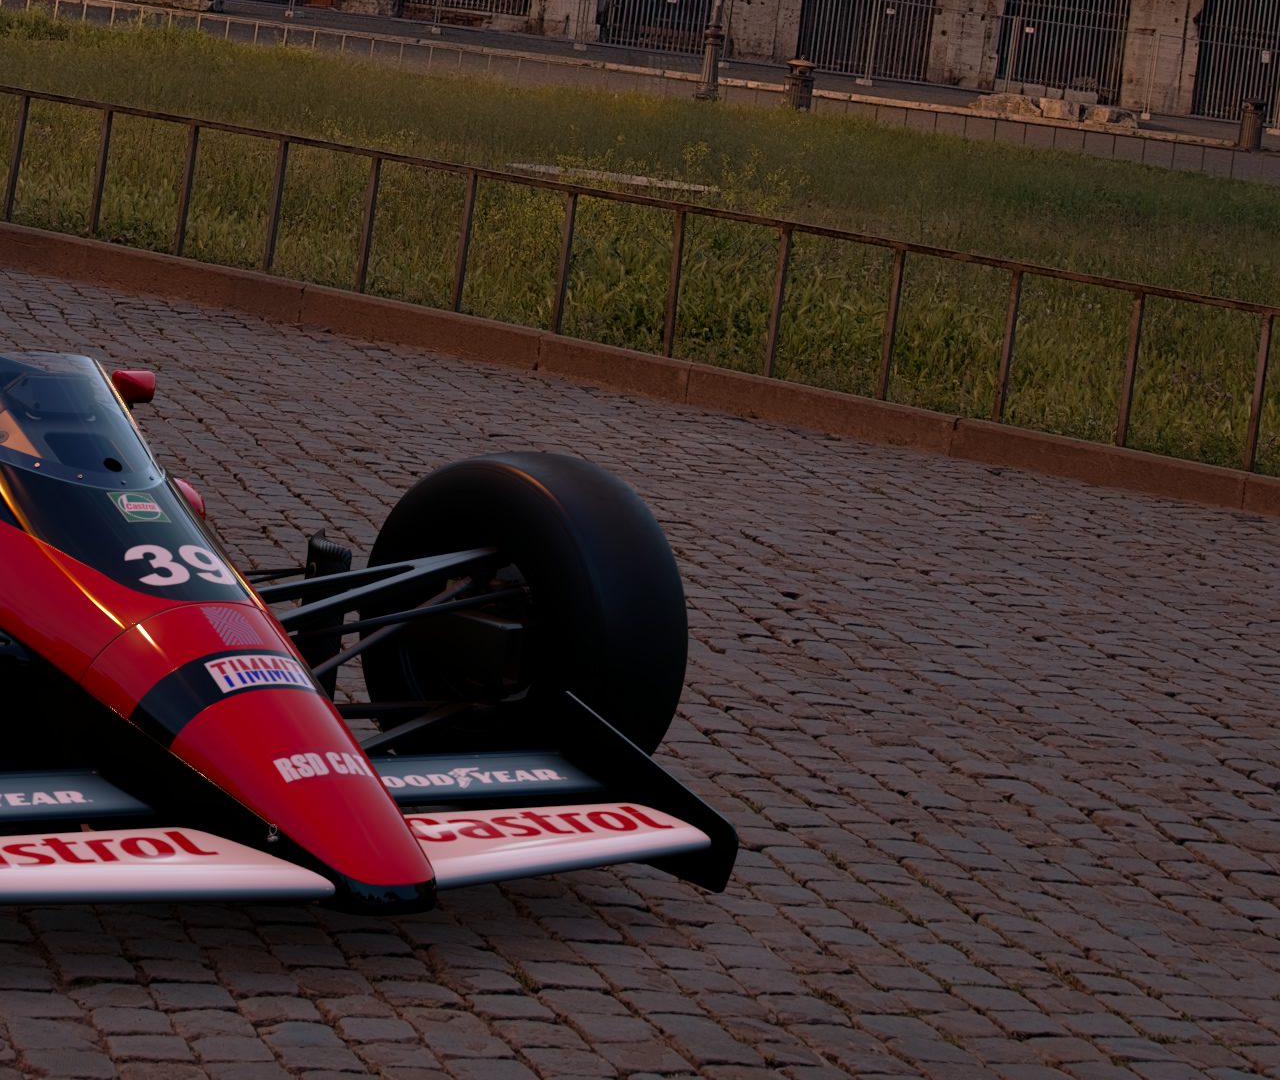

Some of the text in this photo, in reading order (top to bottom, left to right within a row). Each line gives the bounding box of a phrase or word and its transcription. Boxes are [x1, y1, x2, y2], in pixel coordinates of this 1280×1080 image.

[124, 544, 237, 586] 39
[273, 752, 330, 783] RSD
[381, 768, 563, 788] OODYEAR
[404, 806, 673, 842] Castrol
